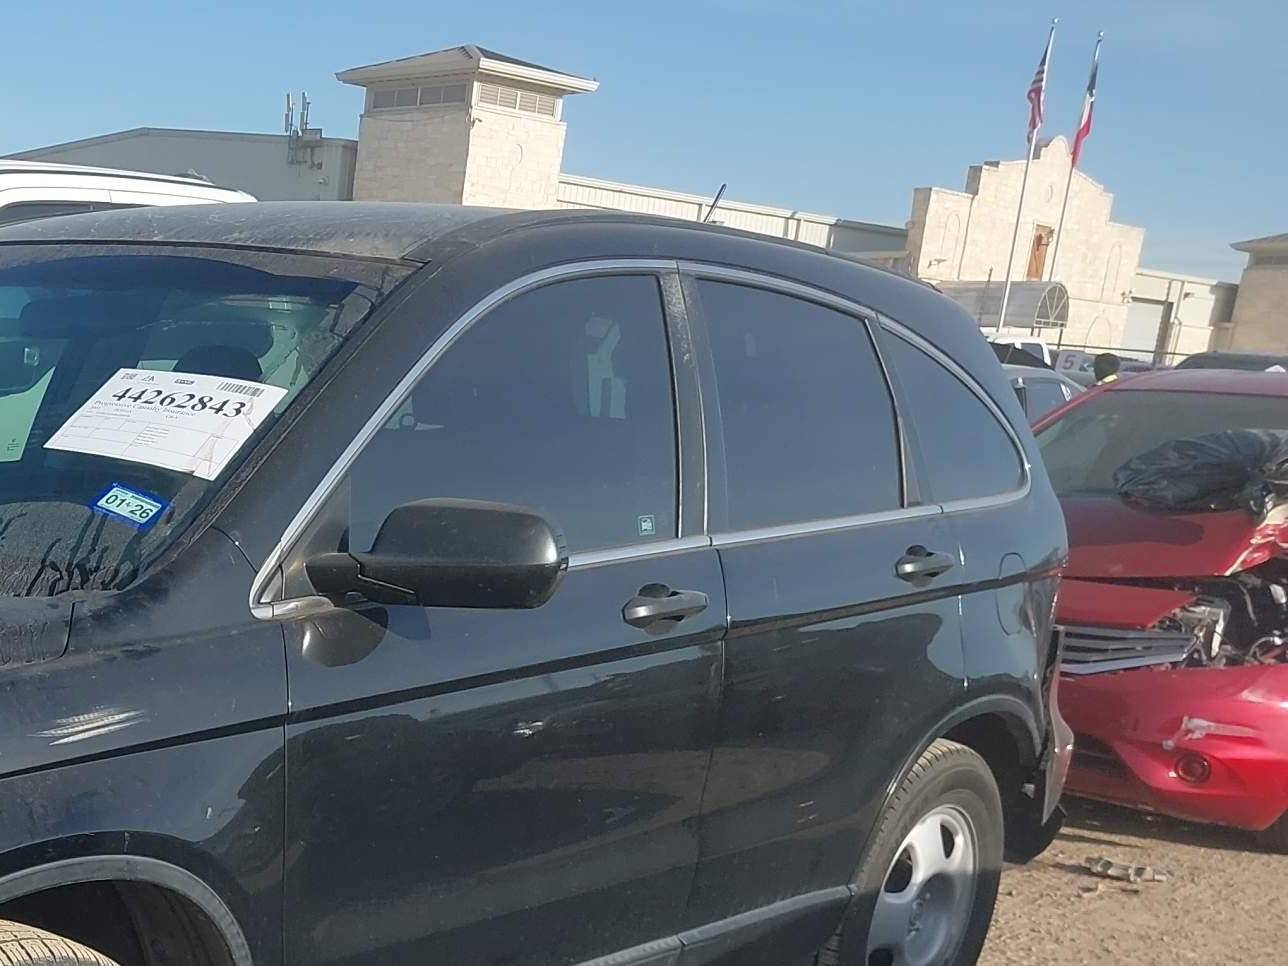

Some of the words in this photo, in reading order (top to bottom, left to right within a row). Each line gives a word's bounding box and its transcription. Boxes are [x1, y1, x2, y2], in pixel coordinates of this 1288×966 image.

[1062, 354, 1077, 369] 5
[111, 386, 247, 419] 44262843
[105, 494, 124, 508] 01
[128, 504, 154, 520] 26
